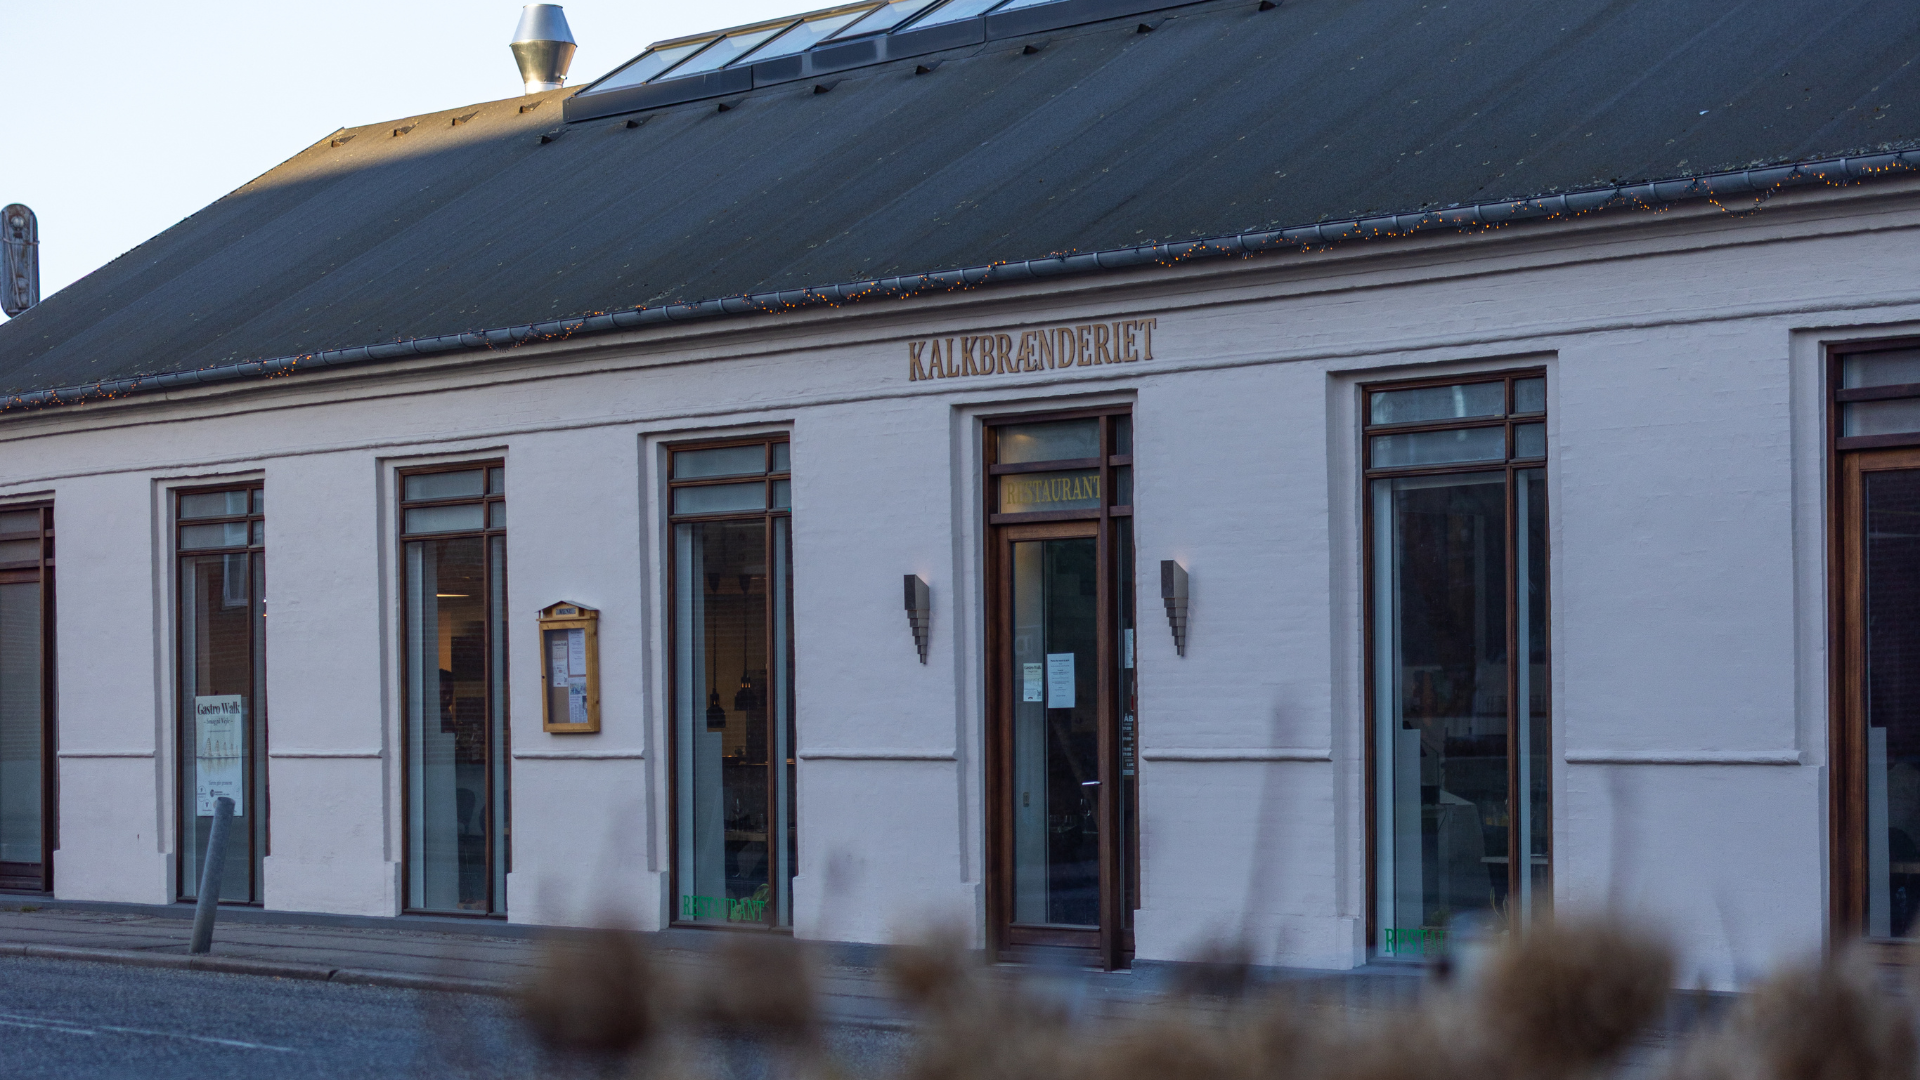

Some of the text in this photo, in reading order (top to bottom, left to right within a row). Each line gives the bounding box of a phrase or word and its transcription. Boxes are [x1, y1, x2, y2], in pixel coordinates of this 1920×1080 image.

[908, 317, 1157, 381] KALKBRÆNDERIET
[1006, 475, 1101, 505] RESTAURANT
[197, 701, 240, 715] Gastro Walk
[1124, 713, 1134, 722] ÅB
[683, 895, 765, 921] RESTAURANT
[1385, 928, 1450, 954] RESTAU
